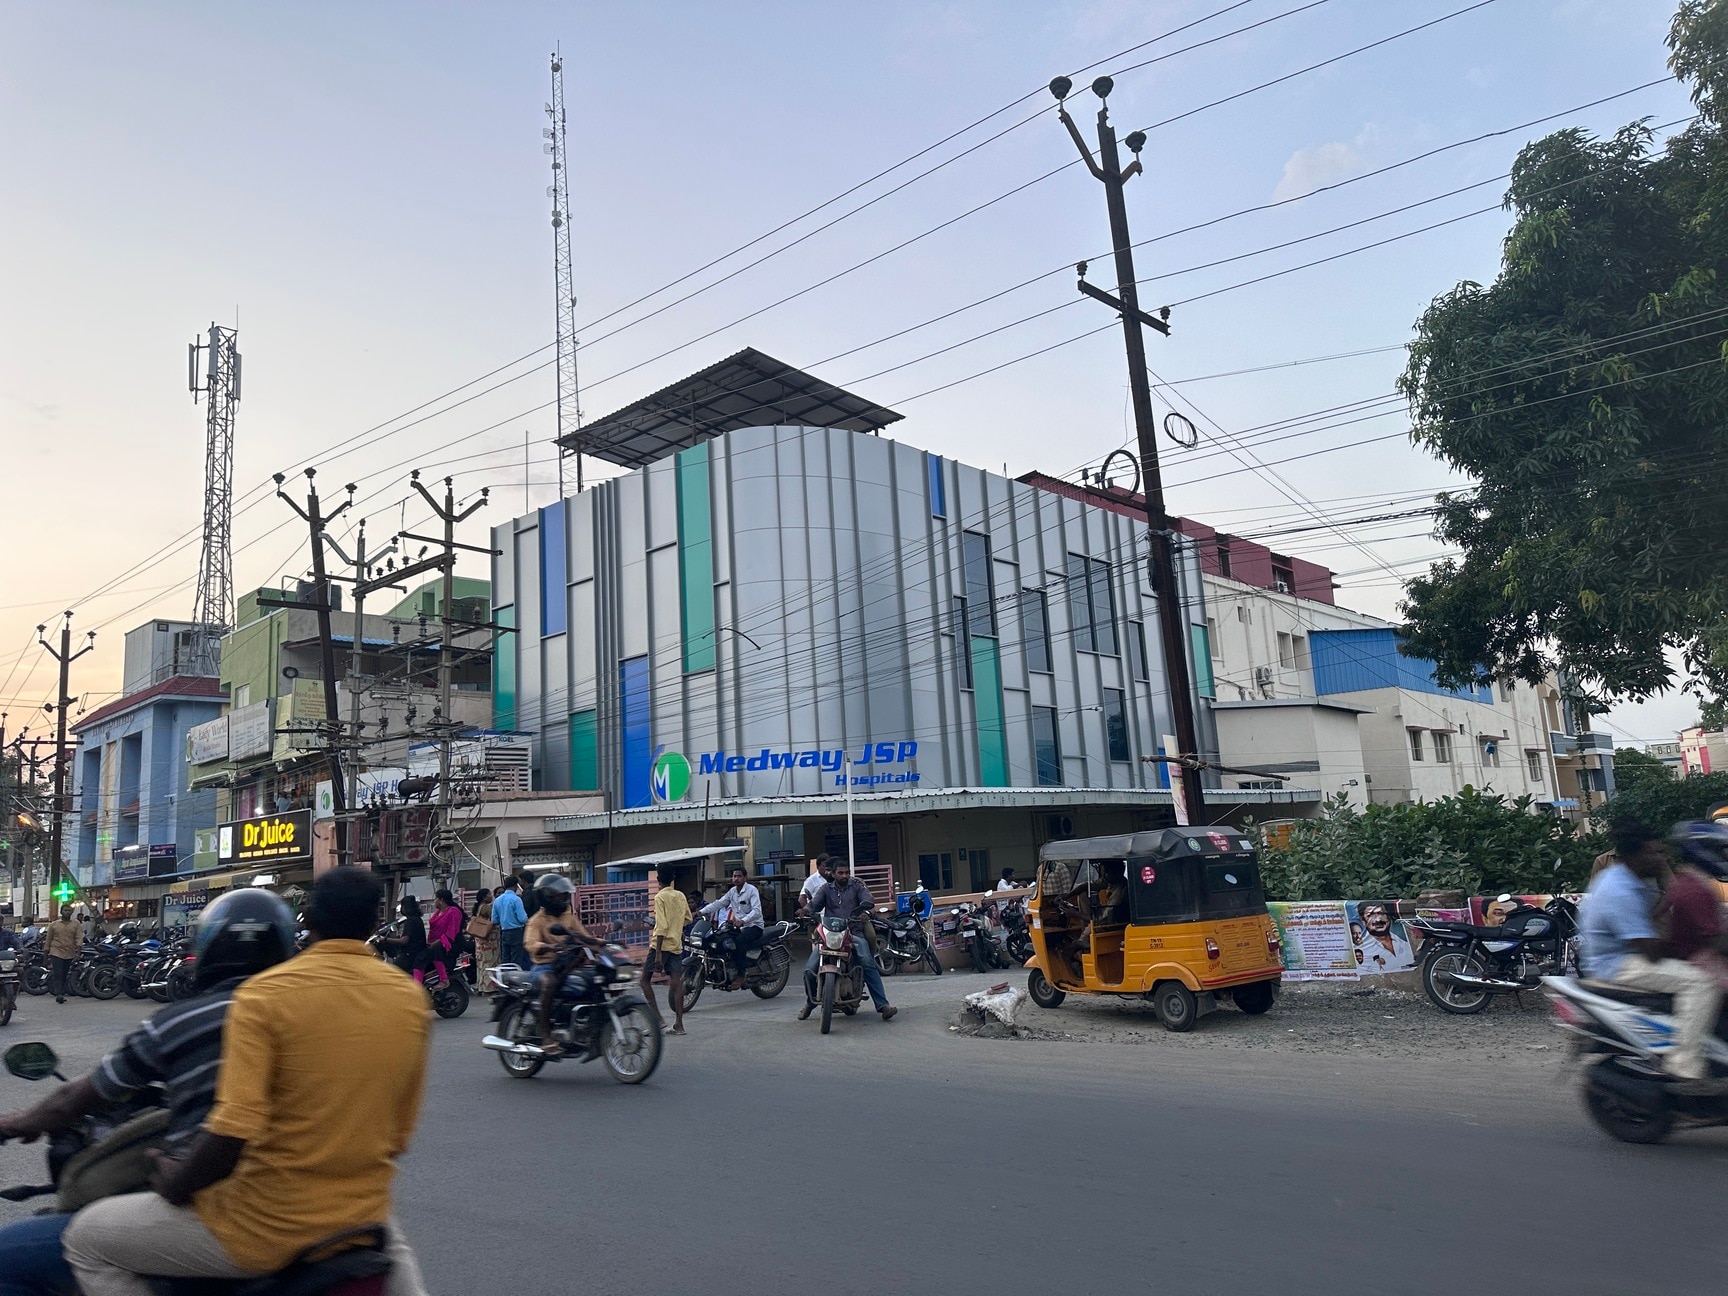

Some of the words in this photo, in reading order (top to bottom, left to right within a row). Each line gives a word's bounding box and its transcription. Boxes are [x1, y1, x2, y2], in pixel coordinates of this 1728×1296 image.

[699, 749, 843, 776] Medway
[854, 741, 918, 765] JSP
[835, 771, 920, 787] Hospitals
[243, 822, 260, 847] Dr
[259, 818, 296, 848] Juice
[165, 896, 178, 906] Dr
[180, 894, 207, 905] Juice
[1207, 960, 1221, 972] Stop
